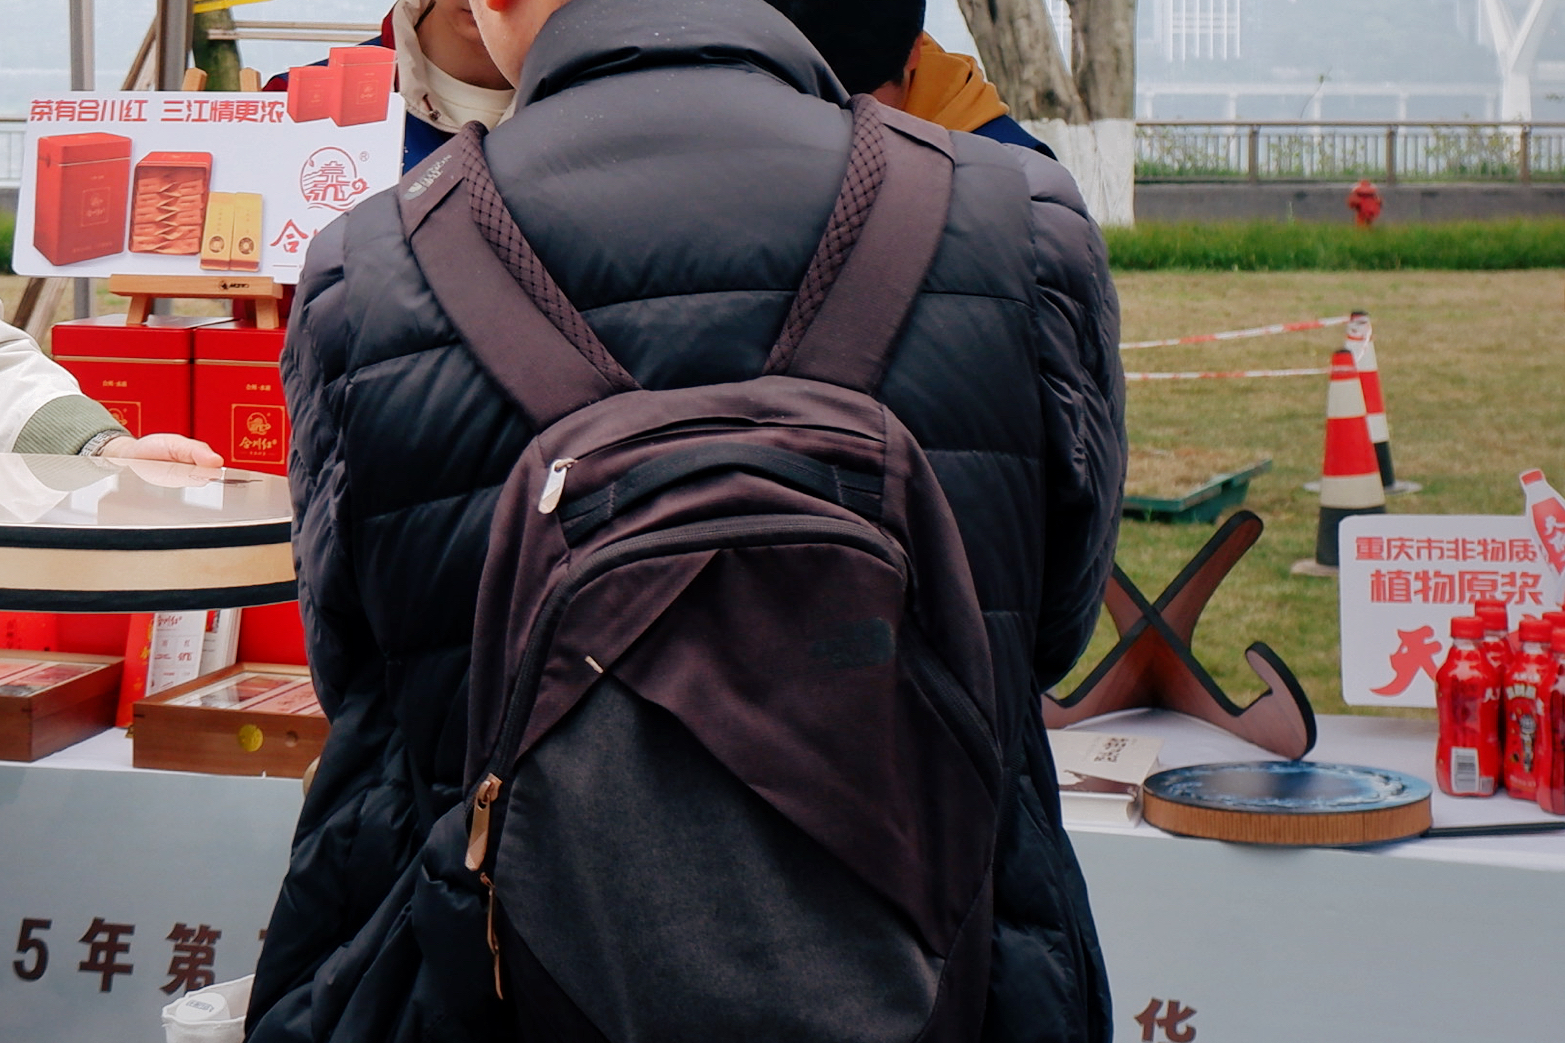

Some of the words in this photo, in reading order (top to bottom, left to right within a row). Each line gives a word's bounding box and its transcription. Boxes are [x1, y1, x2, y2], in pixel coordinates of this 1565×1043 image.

[160, 99, 285, 124] 三江情更浓
[271, 219, 319, 254] 合
[1355, 536, 1538, 563] 重庆市非物质
[1370, 569, 1543, 605] 植物原浆
